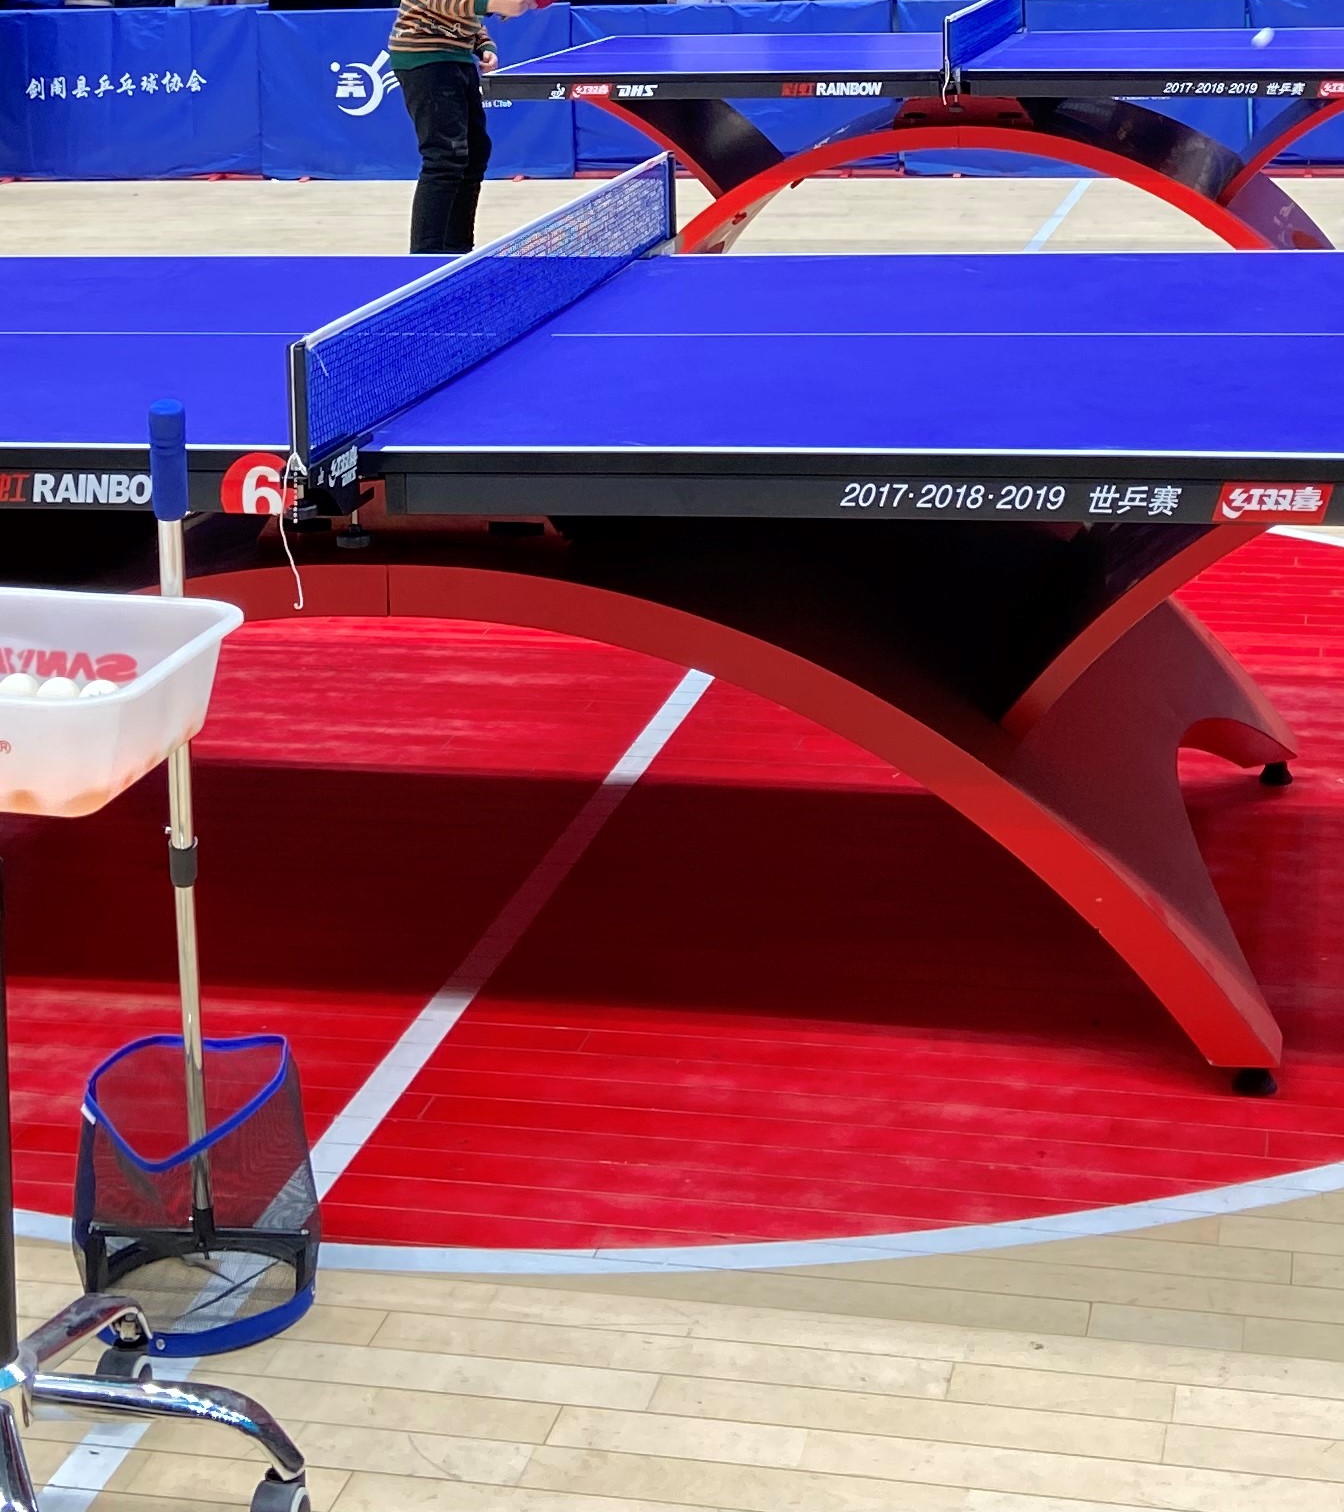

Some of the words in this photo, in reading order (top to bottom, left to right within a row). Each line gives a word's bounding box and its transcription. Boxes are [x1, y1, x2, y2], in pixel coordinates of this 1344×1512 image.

[616, 85, 658, 97] DHS
[816, 82, 883, 96] RAINBOW
[32, 473, 152, 504] RAINBO
[241, 465, 284, 514] 6
[1088, 484, 1182, 516] 世乒赛
[1222, 486, 1323, 519] 红双喜
